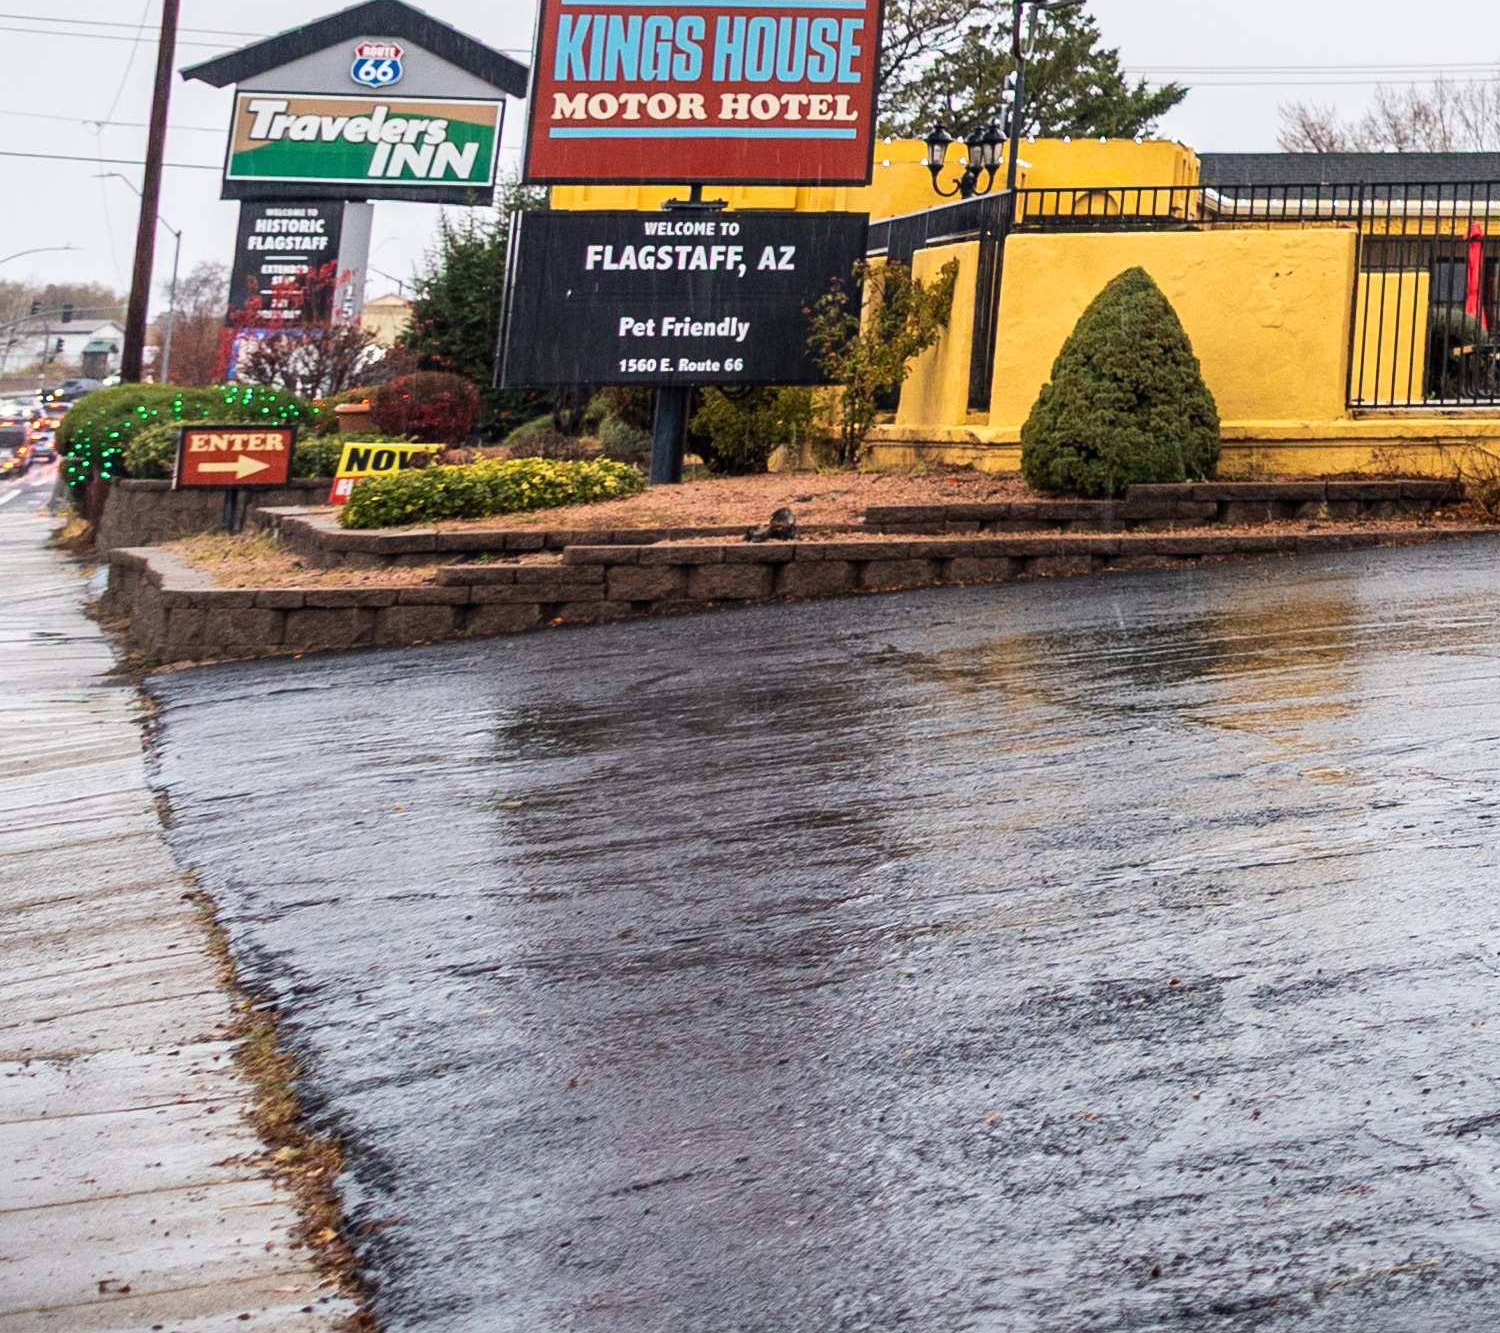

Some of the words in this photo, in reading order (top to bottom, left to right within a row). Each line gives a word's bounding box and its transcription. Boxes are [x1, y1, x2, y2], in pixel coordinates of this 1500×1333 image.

[363, 45, 396, 57] ROUTE
[554, 14, 706, 82] KINGS
[712, 15, 865, 83] HOUSE
[358, 59, 394, 82] 66
[551, 92, 708, 120] MOTOR
[718, 93, 859, 121] HOTEL
[248, 99, 449, 145] Travelers
[366, 142, 480, 180] INN
[265, 208, 306, 217] WELCOME
[307, 208, 319, 217] TO
[255, 218, 326, 233] HISTORIC
[644, 222, 716, 236] WELCOME
[720, 222, 740, 236] TO
[247, 235, 329, 251] FLAGSTAFF
[585, 245, 747, 278] FLAGSTAFF,
[757, 245, 796, 270] AZ
[618, 317, 655, 337] Pet
[661, 316, 751, 342] Friendly
[619, 358, 657, 373] 1560
[660, 358, 674, 372] E.
[678, 358, 720, 372] Route
[724, 358, 744, 372] 66
[189, 434, 284, 452] ENTER
